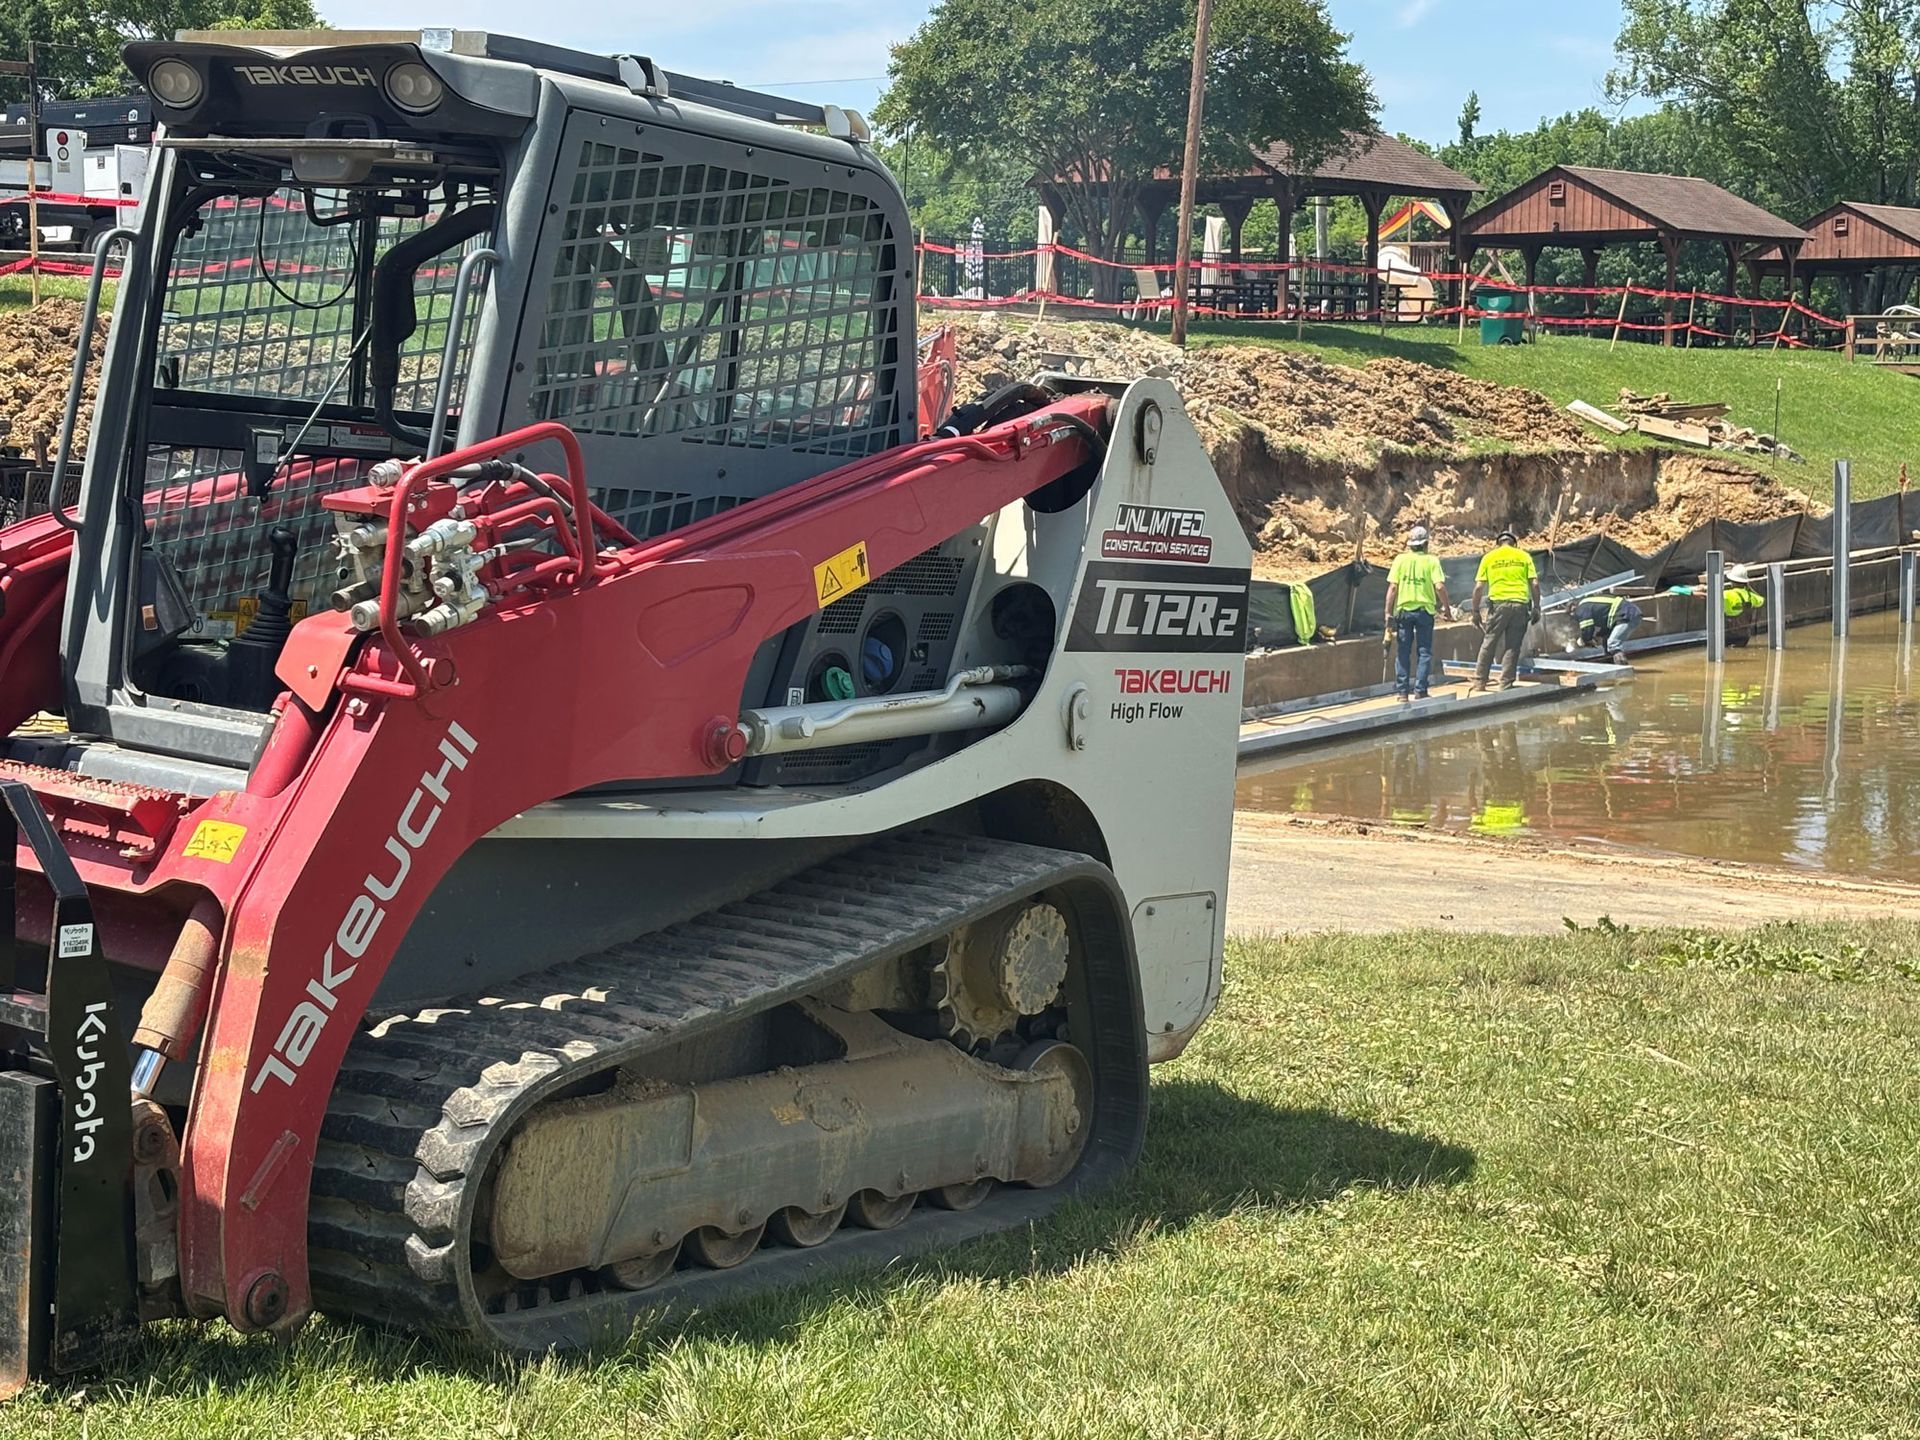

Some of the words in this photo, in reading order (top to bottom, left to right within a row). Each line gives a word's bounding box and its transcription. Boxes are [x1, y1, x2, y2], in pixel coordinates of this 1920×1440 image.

[233, 66, 377, 87] TAKEUCH
[1115, 507, 1205, 537] UNLIMITED
[1104, 538, 1169, 553] CONSTRUCTION
[1169, 542, 1209, 557] SERVICES
[1094, 579, 1246, 637] TL12R2
[1114, 669, 1231, 694] TAKEUCHI
[1110, 703, 1144, 723] High
[1149, 702, 1183, 718] Flow
[250, 720, 478, 1095] TAKEUCHI
[73, 1002, 107, 1163] Kubota
